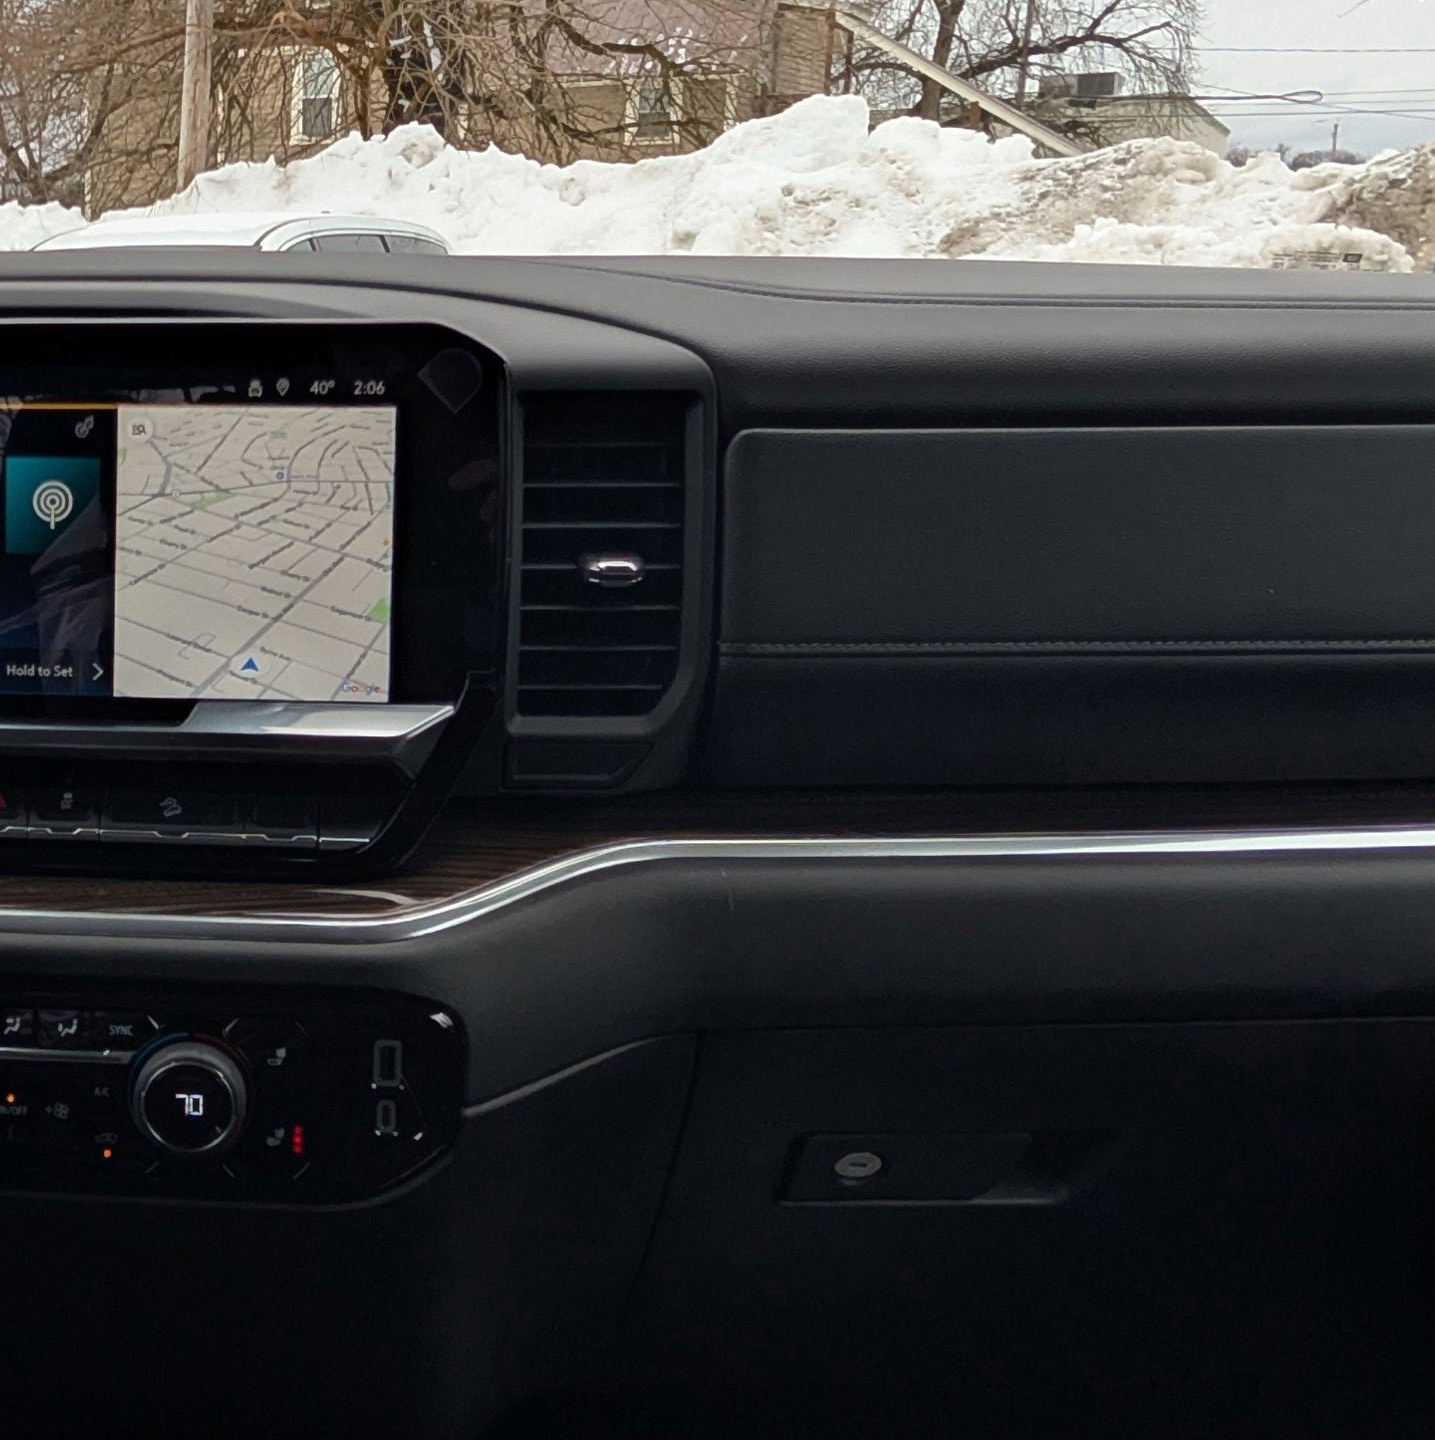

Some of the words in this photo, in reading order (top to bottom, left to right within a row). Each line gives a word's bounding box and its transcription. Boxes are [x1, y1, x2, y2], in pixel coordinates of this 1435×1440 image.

[353, 379, 386, 396] 2:06
[6, 664, 35, 677] Hold
[38, 666, 51, 677] to
[53, 665, 74, 678] Set
[341, 679, 381, 694] Google
[108, 1024, 134, 1036] SYNC
[175, 1094, 204, 1116] 70
